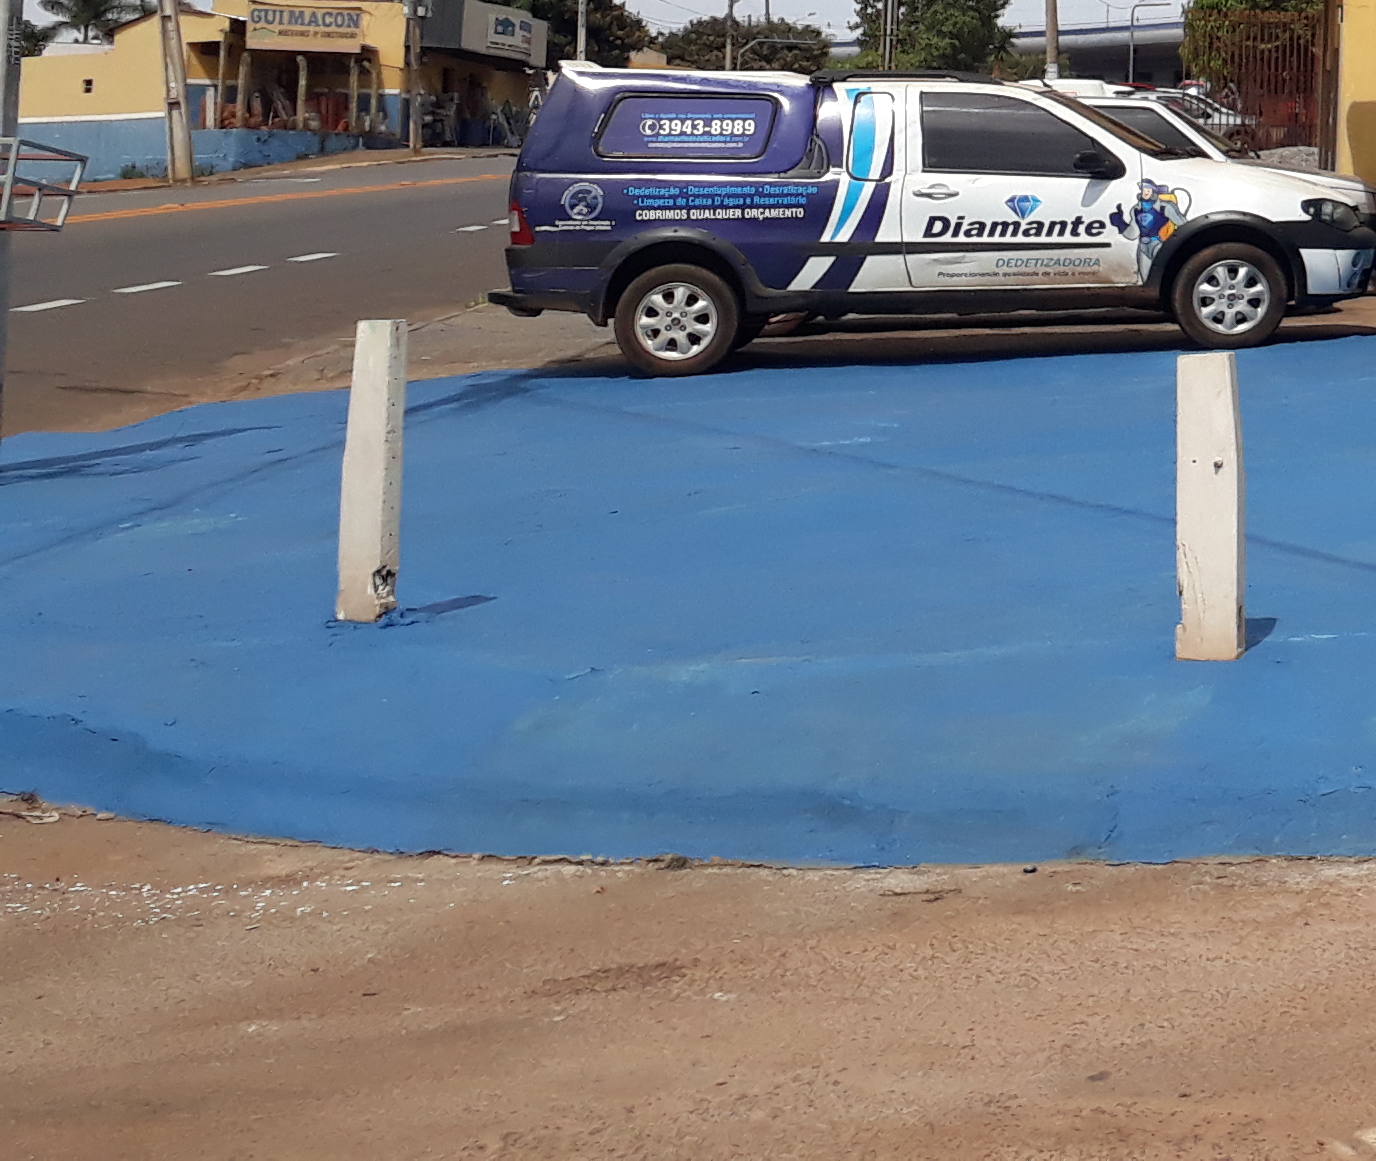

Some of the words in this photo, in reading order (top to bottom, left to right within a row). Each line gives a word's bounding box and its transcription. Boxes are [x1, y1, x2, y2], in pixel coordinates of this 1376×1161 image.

[250, 8, 362, 28] GUIMACON
[659, 119, 755, 135] 3943-8989
[635, 209, 688, 220] COBRIMOS
[690, 208, 742, 219] QUALQUER
[744, 208, 805, 221] ORÇAMENTO
[922, 215, 1107, 238] Diamante
[995, 257, 1101, 268] DEDETIZADORA
